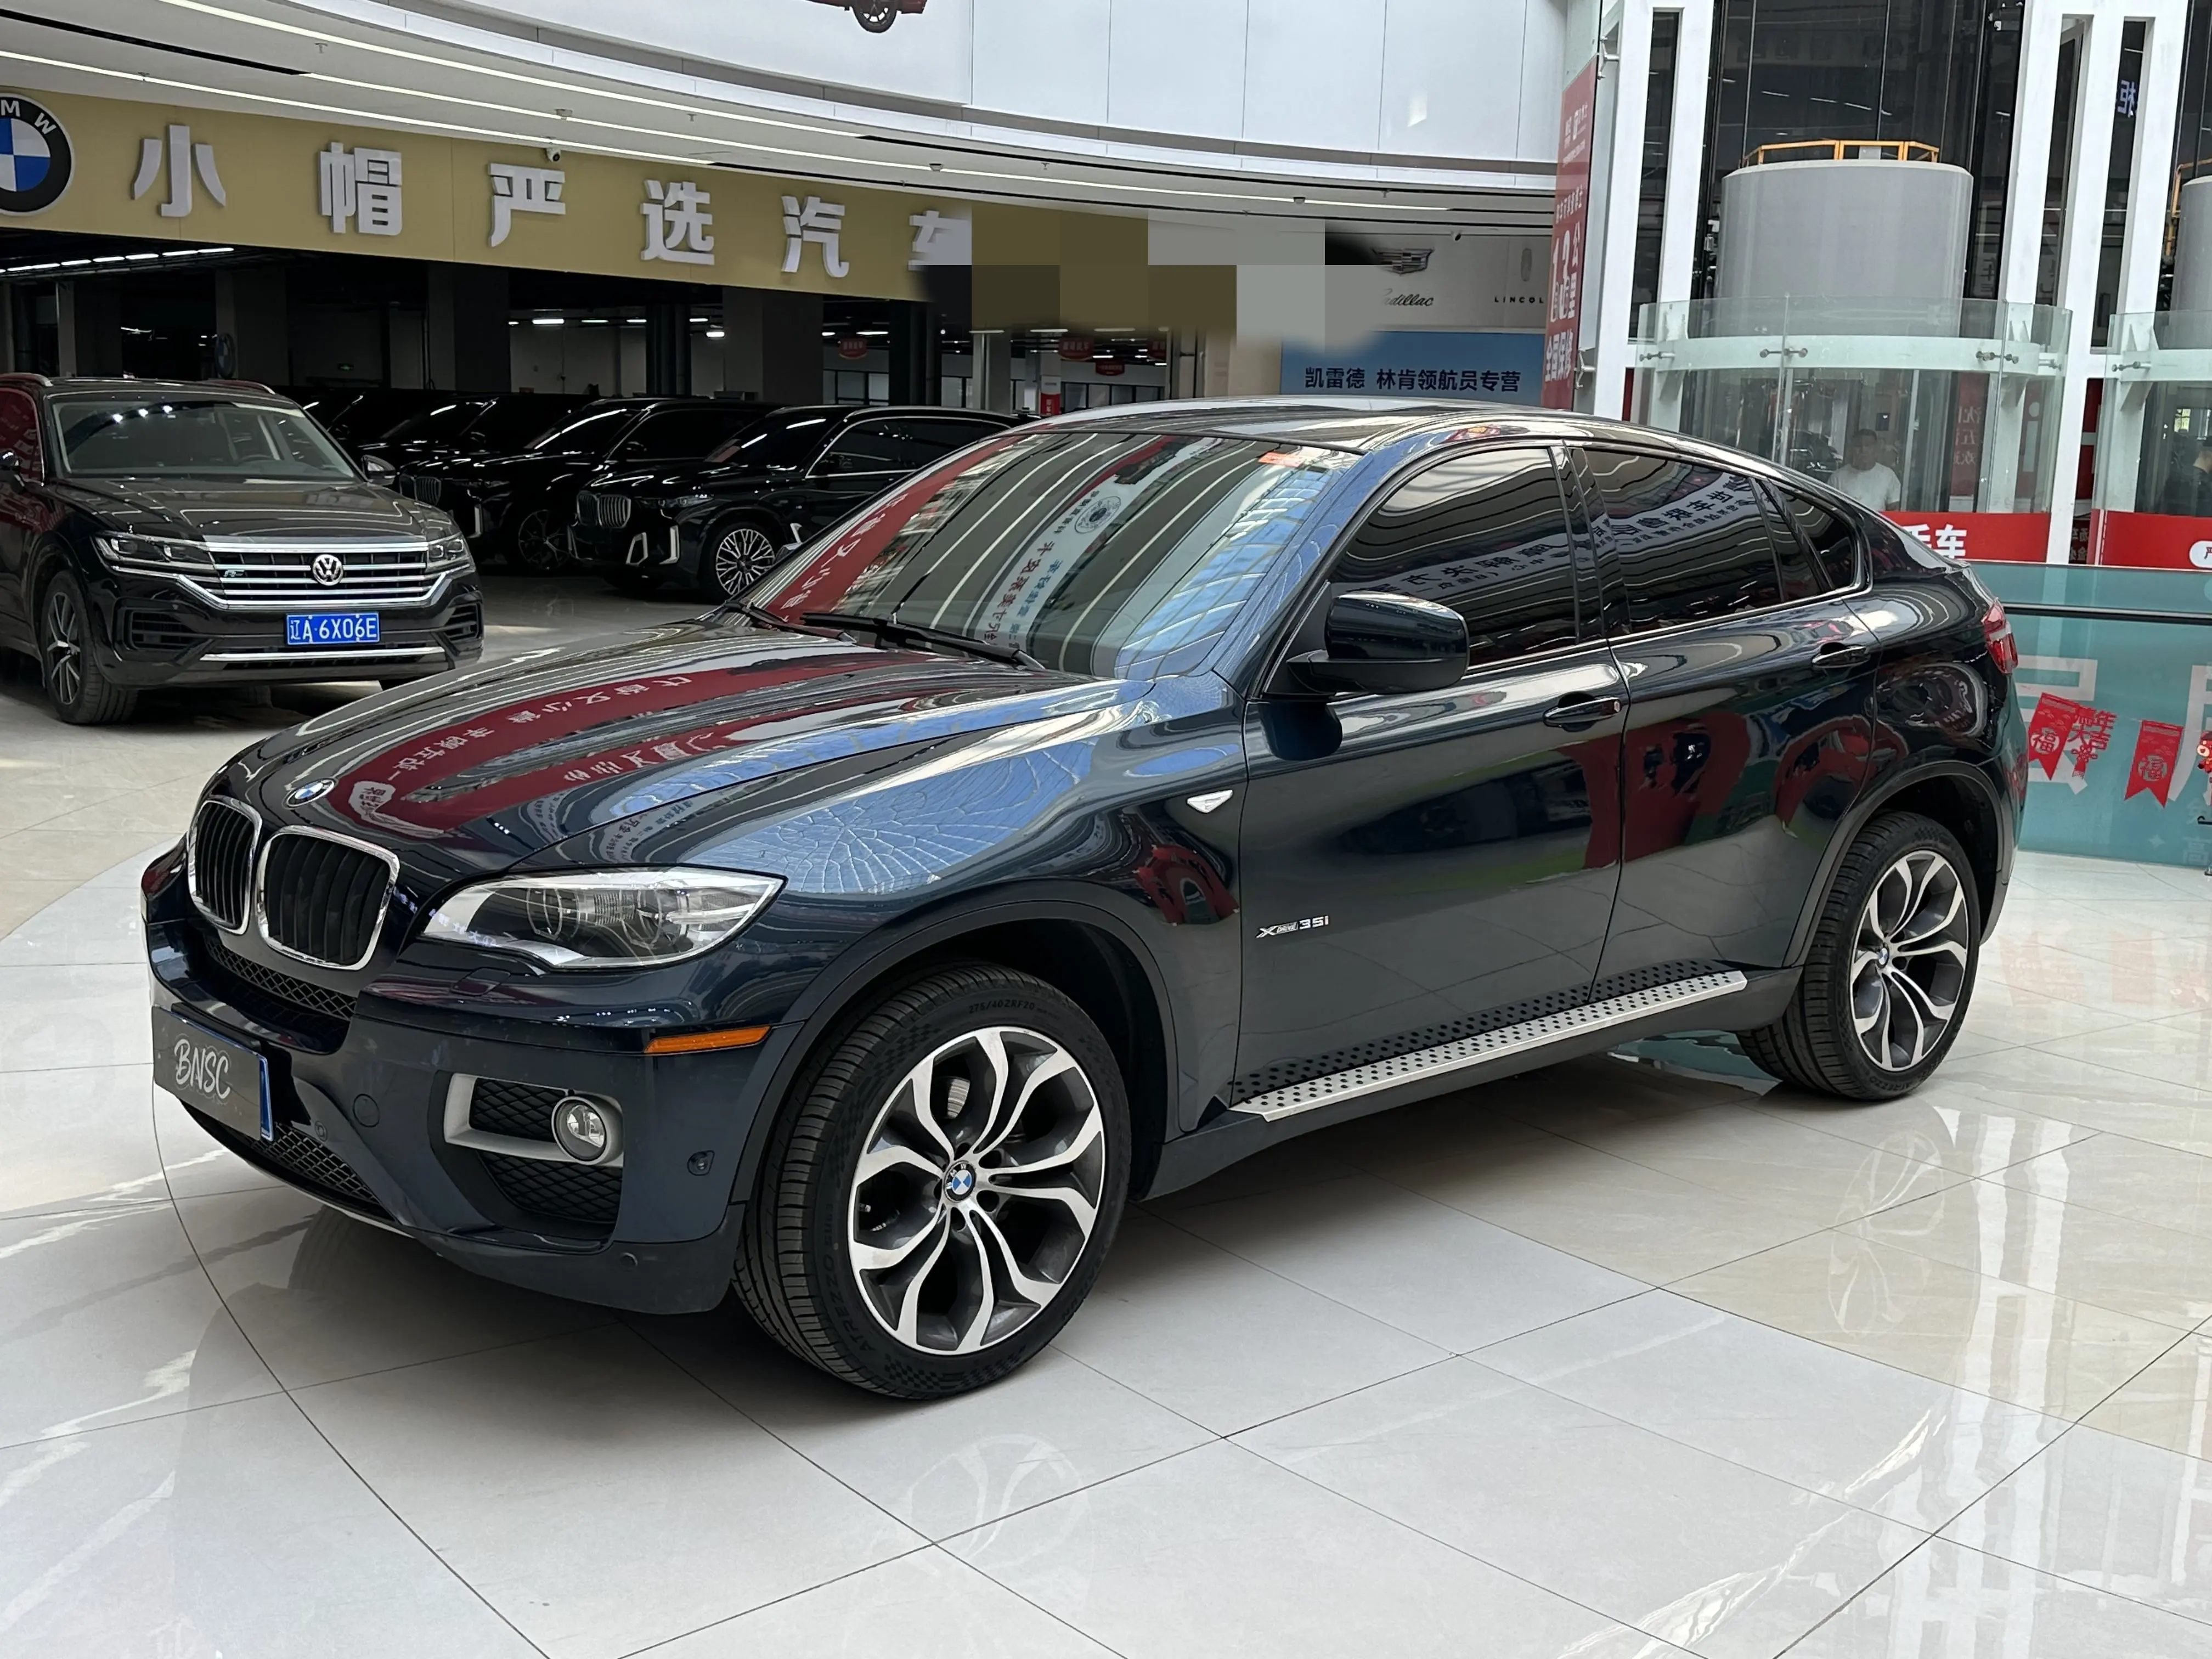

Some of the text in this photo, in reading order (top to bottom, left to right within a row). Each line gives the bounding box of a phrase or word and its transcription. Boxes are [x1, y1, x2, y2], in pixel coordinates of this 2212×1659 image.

[1304, 366, 1521, 392] 凯雷德 林肯领航员专营
